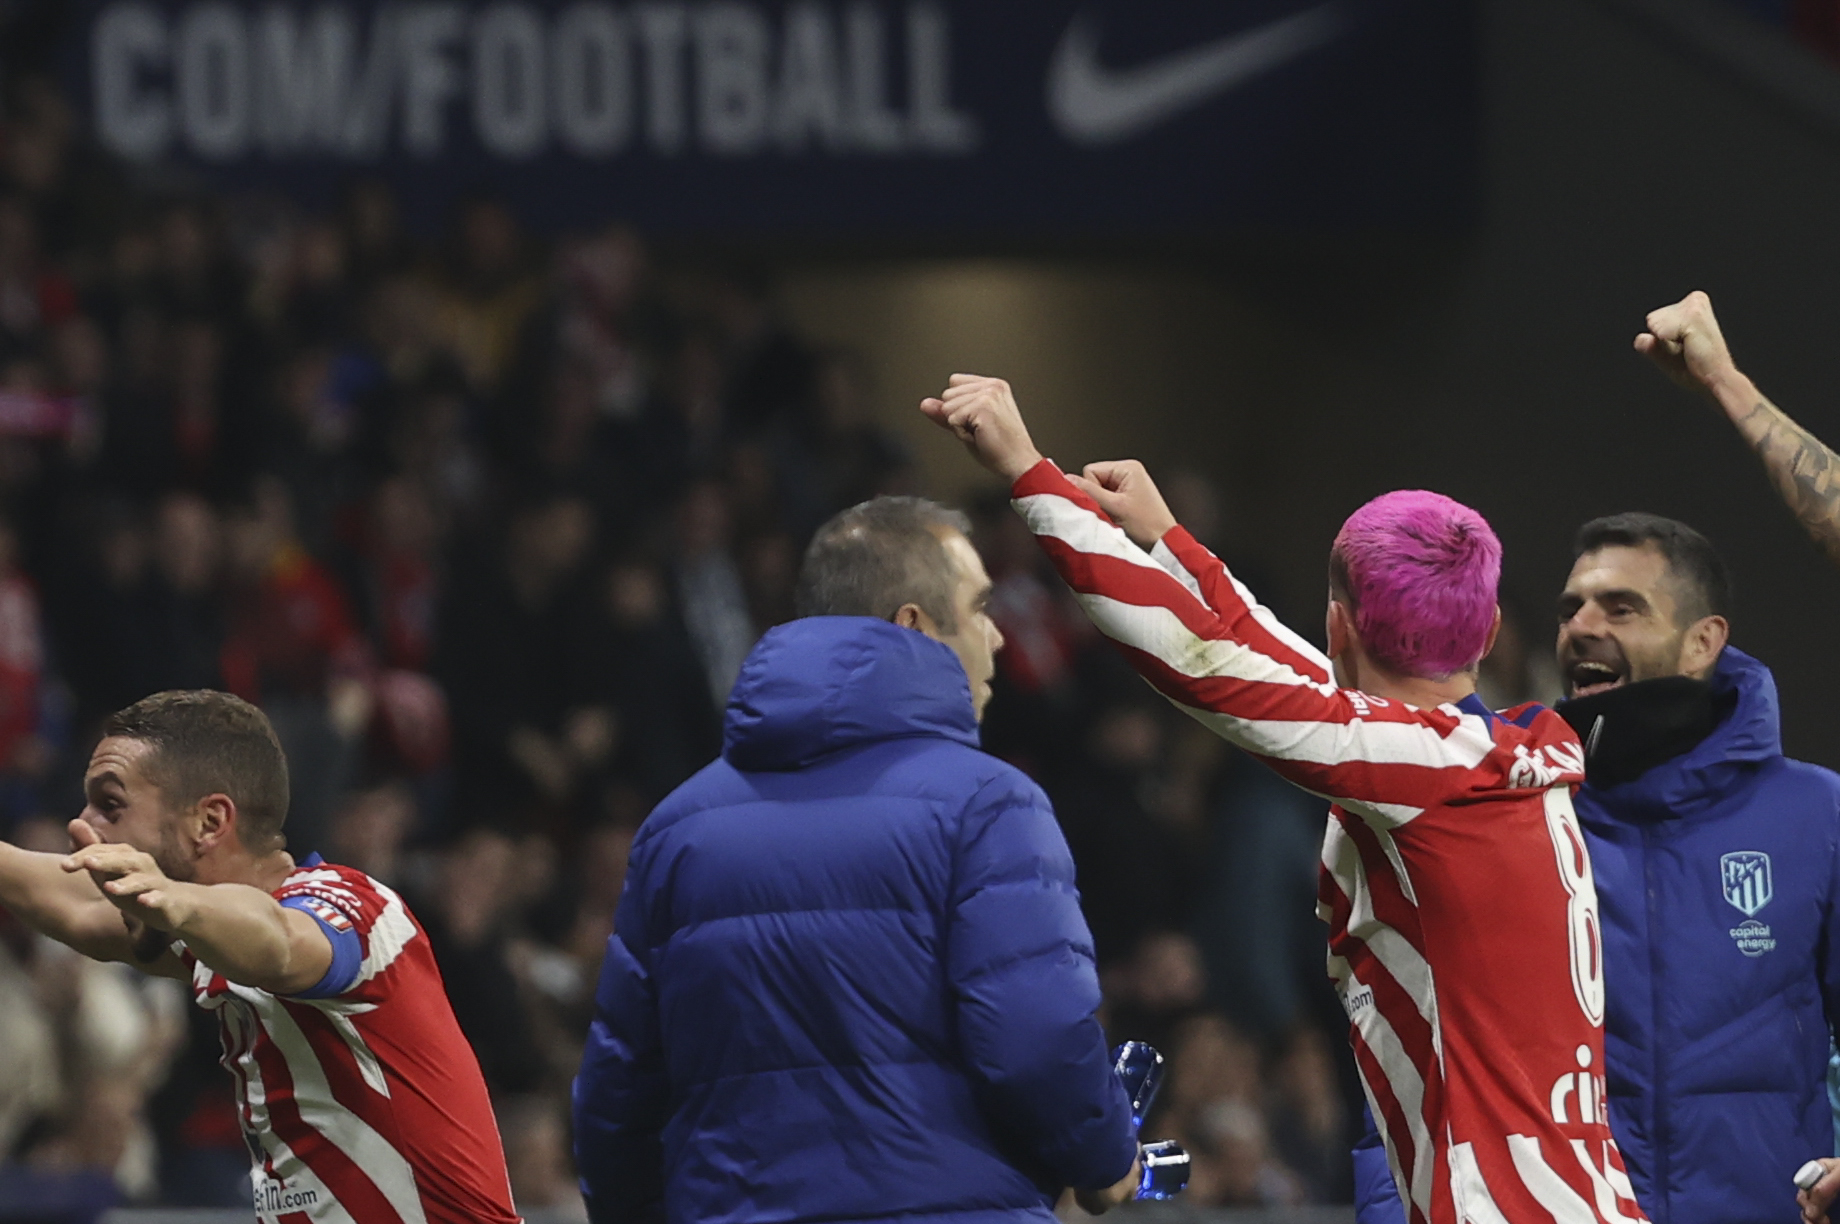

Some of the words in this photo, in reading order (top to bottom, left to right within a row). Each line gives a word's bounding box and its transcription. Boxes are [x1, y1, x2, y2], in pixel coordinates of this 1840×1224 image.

[90, 0, 980, 159] COM/FOOTBALL
[1543, 783, 1605, 1028] 8
[1729, 925, 1771, 938] capital
[1737, 938, 1777, 951] energy
